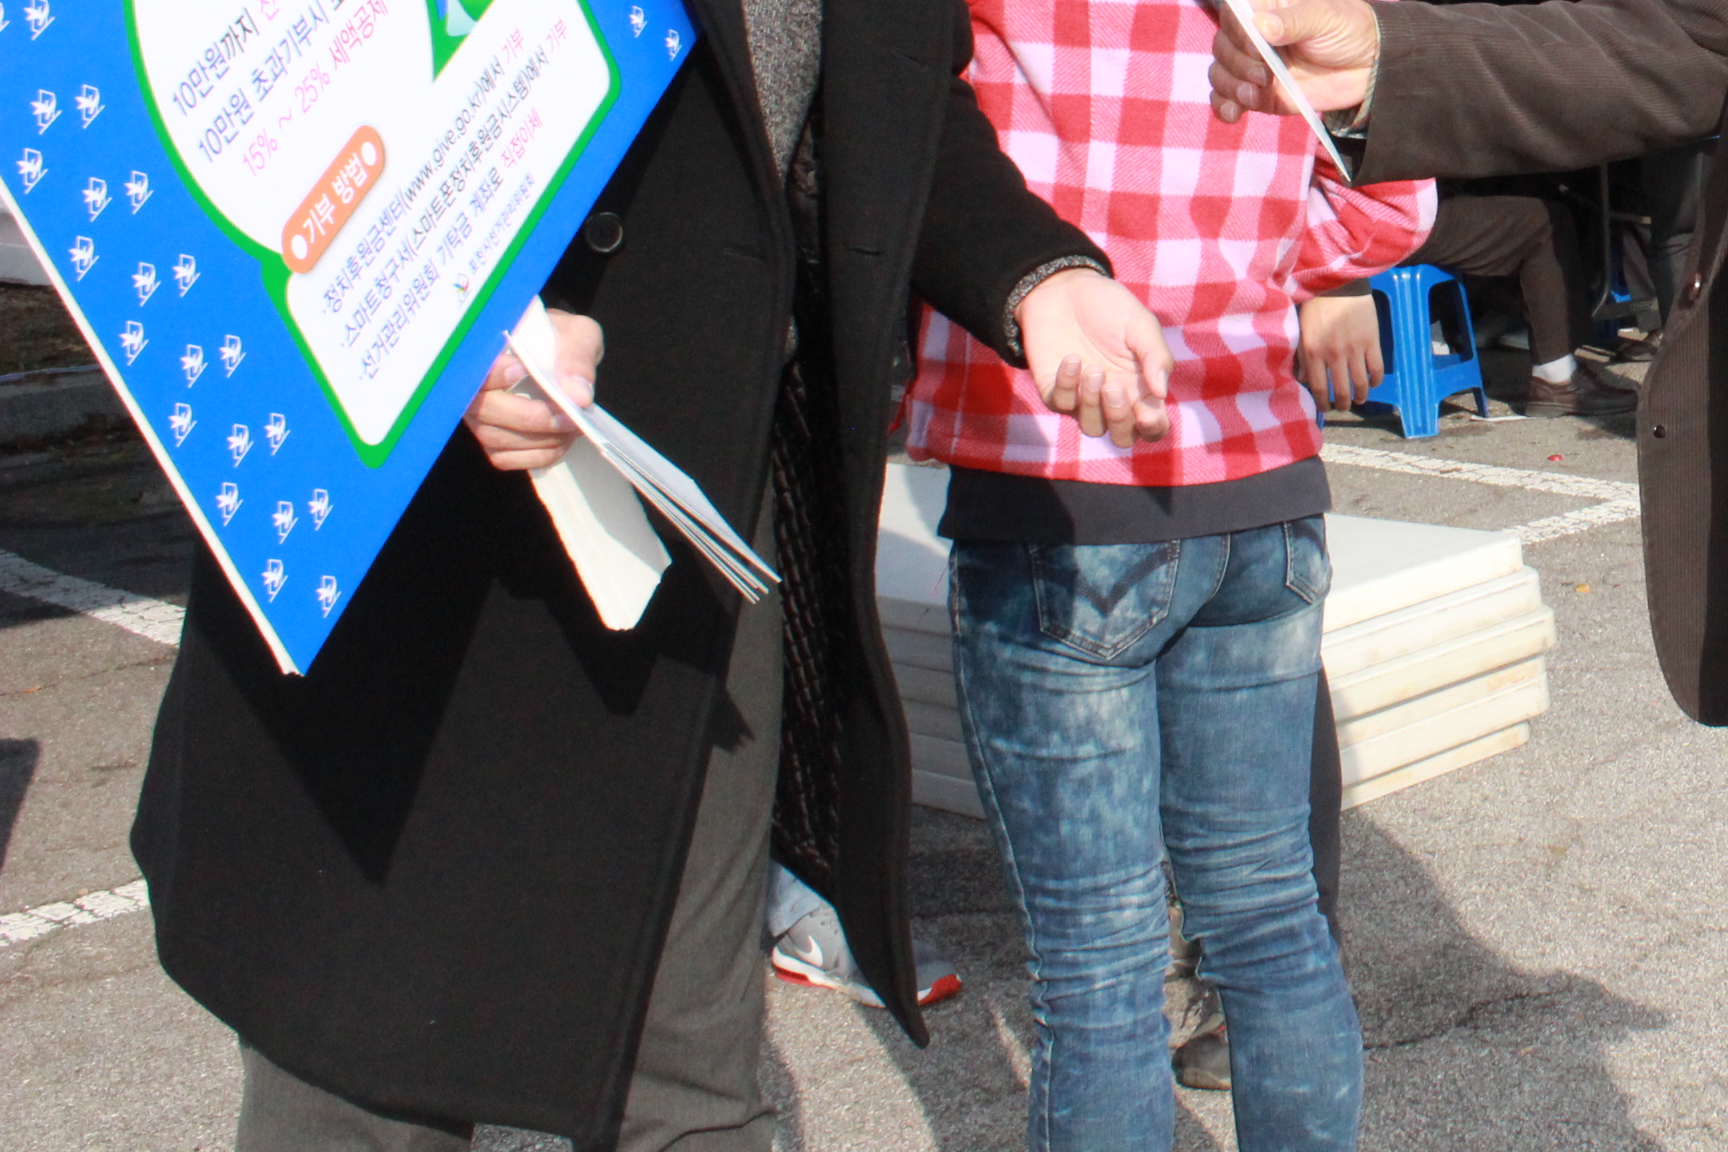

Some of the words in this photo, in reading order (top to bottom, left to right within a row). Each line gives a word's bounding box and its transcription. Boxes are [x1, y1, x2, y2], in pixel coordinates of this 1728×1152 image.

[172, 8, 259, 116] 10만원까지
[502, 27, 524, 64] 기부
[546, 17, 568, 54] 기부
[198, 88, 254, 162] 10만원
[243, 130, 277, 176] 15%
[295, 69, 329, 113] 25%
[303, 193, 336, 243] 기부
[332, 153, 368, 204] 방법
